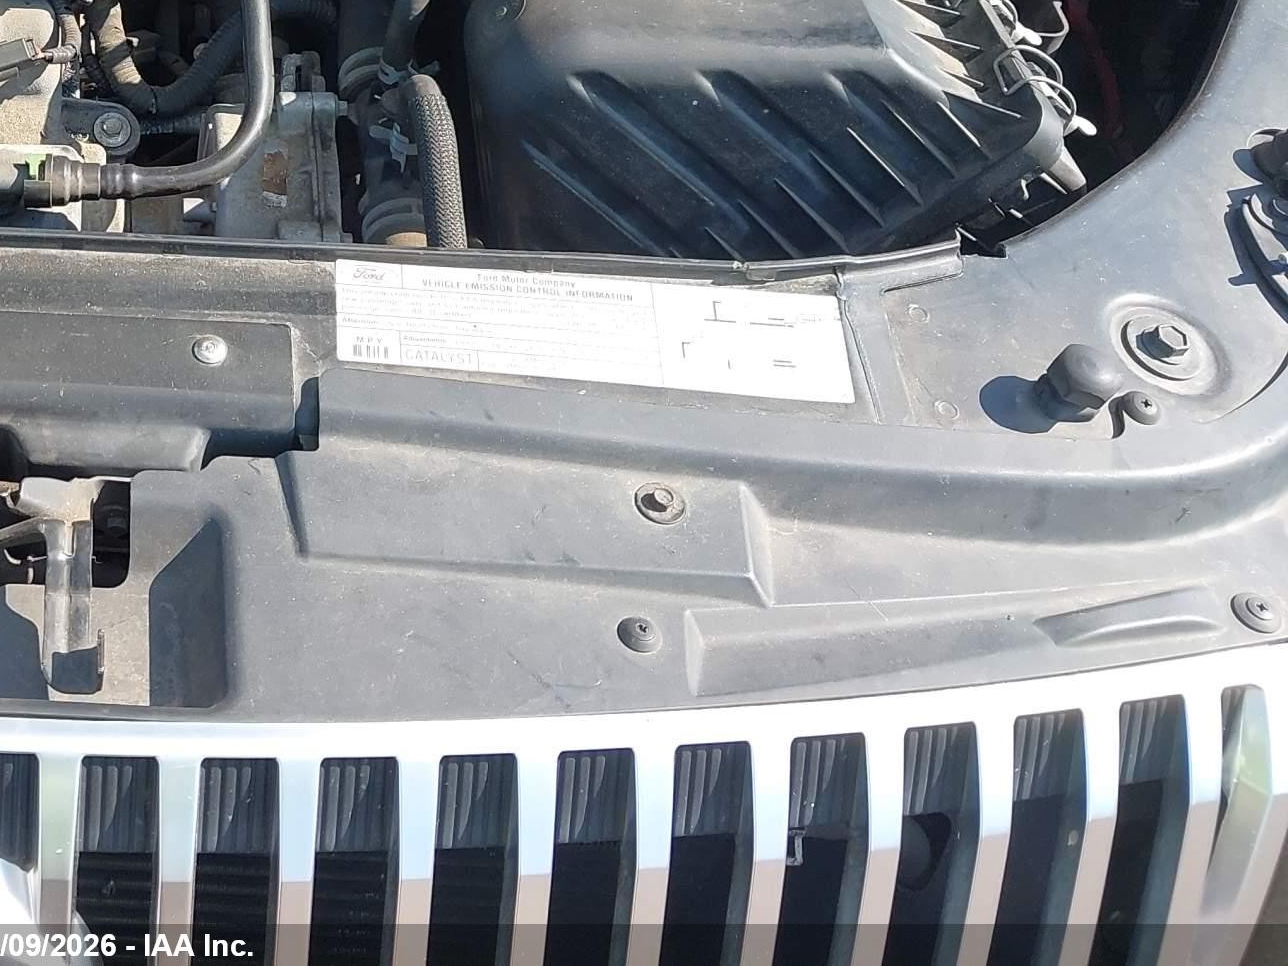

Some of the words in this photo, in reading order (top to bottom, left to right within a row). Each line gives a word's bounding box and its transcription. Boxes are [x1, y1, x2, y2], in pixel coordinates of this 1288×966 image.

[352, 267, 386, 282] Ford
[477, 272, 499, 283] Ford
[501, 274, 530, 284] Motor
[532, 277, 576, 289] Company
[422, 279, 461, 290] VEHICLE
[465, 281, 513, 293] EMISSION
[516, 285, 561, 297] CONTROL
[565, 289, 633, 302] INFORMATION
[405, 348, 472, 364] CATALYST
